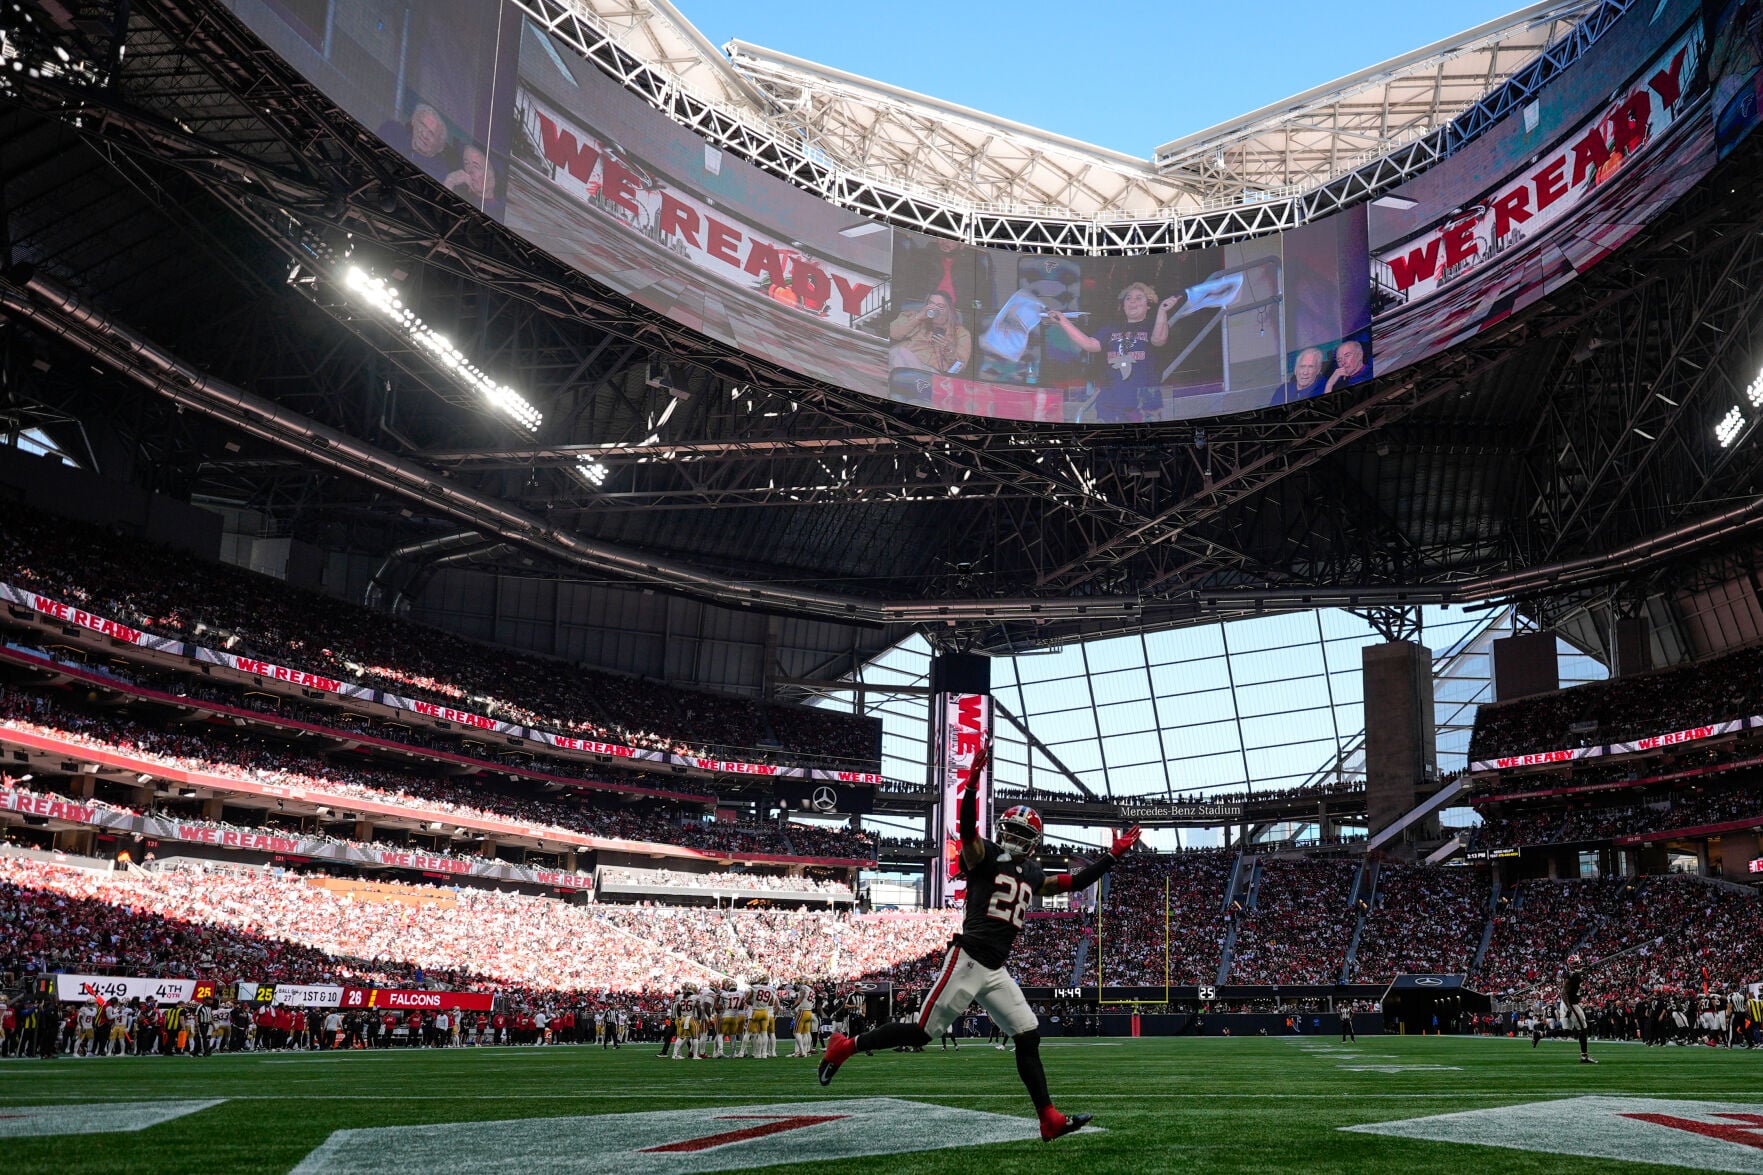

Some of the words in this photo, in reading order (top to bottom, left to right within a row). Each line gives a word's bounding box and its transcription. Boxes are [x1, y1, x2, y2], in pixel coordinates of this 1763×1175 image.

[1387, 217, 1479, 292] WE
[1489, 45, 1689, 239] READY
[538, 110, 644, 215] WE
[659, 192, 873, 317] READY
[35, 596, 68, 620] WE
[73, 610, 142, 643] READY
[237, 656, 269, 675] WE
[275, 667, 341, 692] READY
[415, 700, 440, 716] WE
[445, 708, 497, 730] READY
[555, 735, 577, 749] WE
[582, 741, 636, 757] READY
[1638, 736, 1660, 750] WE
[1664, 725, 1714, 745] READY
[697, 758, 719, 770] WE
[725, 762, 777, 775] READY
[1497, 757, 1520, 768] WE
[1523, 750, 1574, 765] READY
[838, 771, 860, 782] WE
[16, 795, 96, 823] READY
[1120, 806, 1196, 817] Mercedes-Benz
[1198, 805, 1241, 816] Stadium
[179, 825, 217, 842] WE
[222, 831, 299, 852] READY
[381, 852, 409, 867] WE
[415, 856, 472, 874] READY
[537, 871, 560, 884] WE
[986, 873, 1032, 928] 28
[156, 984, 182, 998] 4TH
[197, 986, 212, 998] 25
[256, 987, 273, 1001] 25
[303, 991, 318, 1001] 1ST
[320, 992, 326, 1002] &
[328, 992, 337, 1002] 10
[389, 993, 441, 1006] FALCONS
[757, 989, 771, 1003] 89
[1054, 987, 1081, 998] 14:49
[1200, 987, 1214, 999] 25
